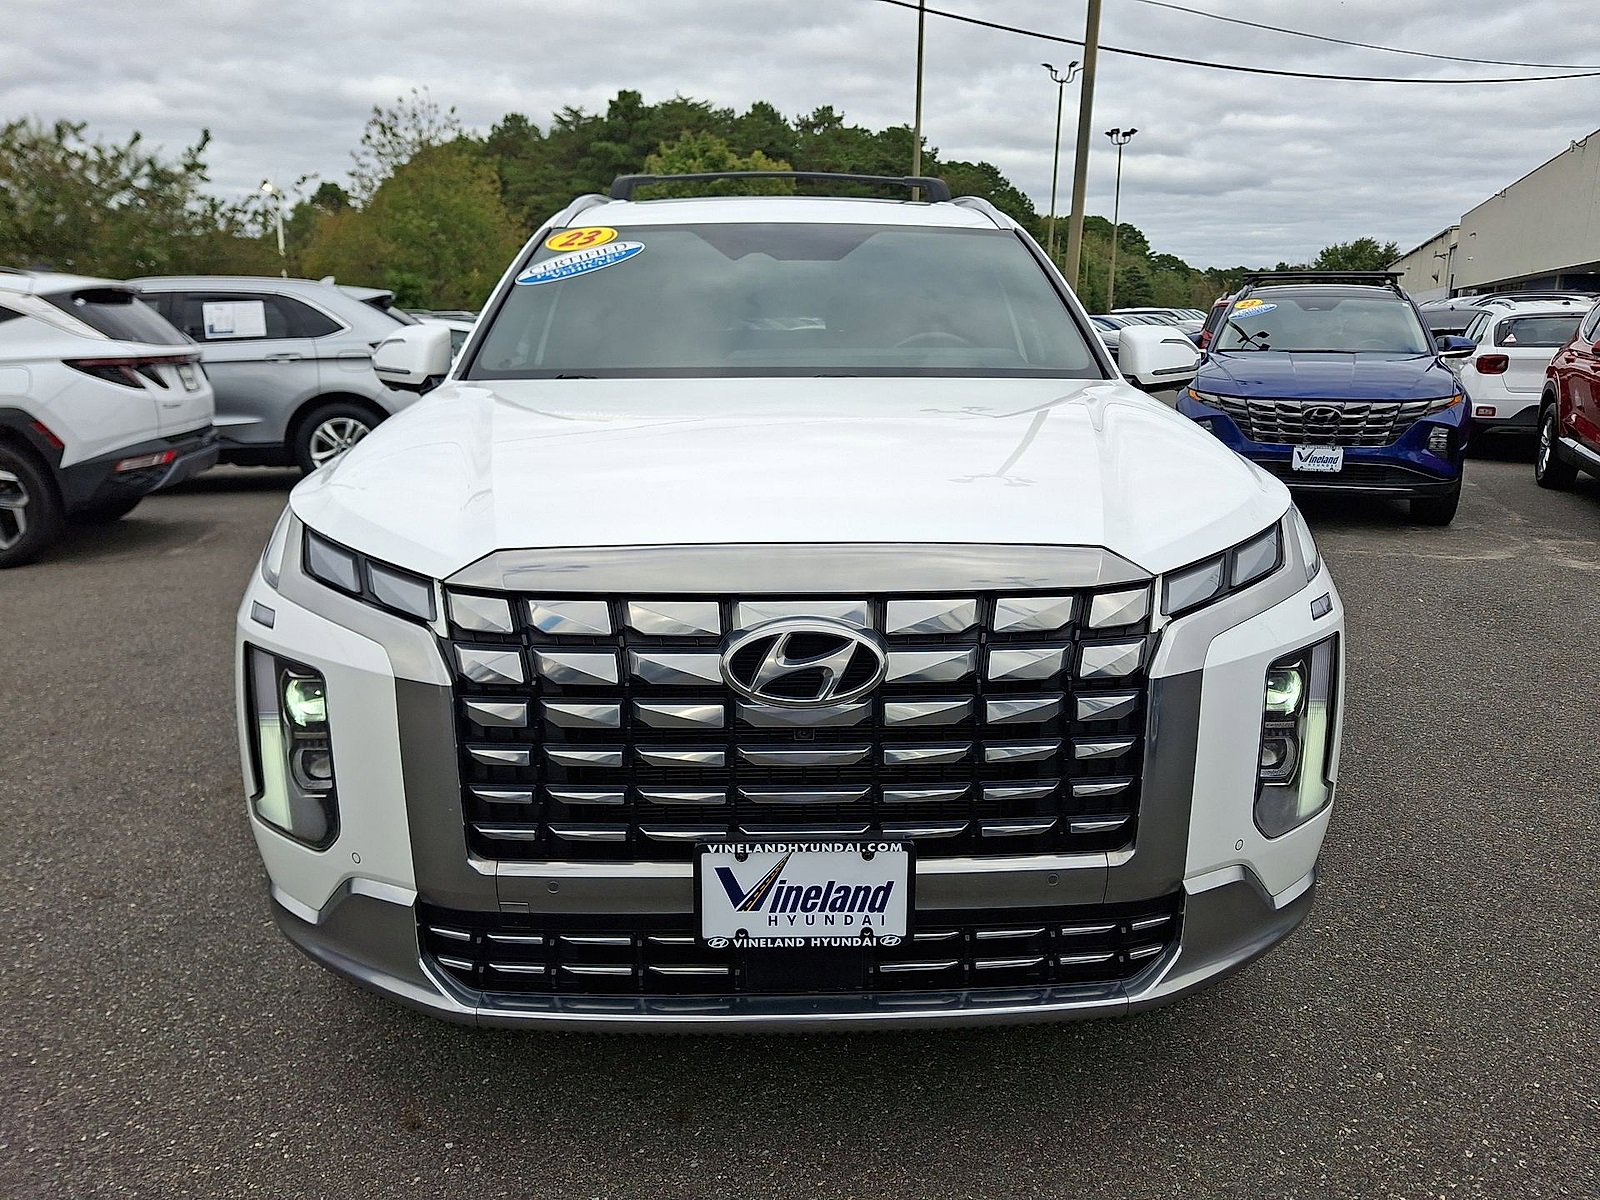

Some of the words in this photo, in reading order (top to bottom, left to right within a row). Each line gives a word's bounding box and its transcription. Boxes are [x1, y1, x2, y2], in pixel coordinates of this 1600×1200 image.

[559, 230, 602, 246] 23
[529, 243, 628, 274] CERTIFIED
[1296, 449, 1340, 464] Vineland
[707, 843, 903, 854] VINELANDHYUNDAI.COM
[714, 851, 895, 914] Vineland
[768, 915, 886, 927] HYUNDAI
[733, 938, 805, 948] VINELAND
[811, 937, 877, 948] HYUNDAI
